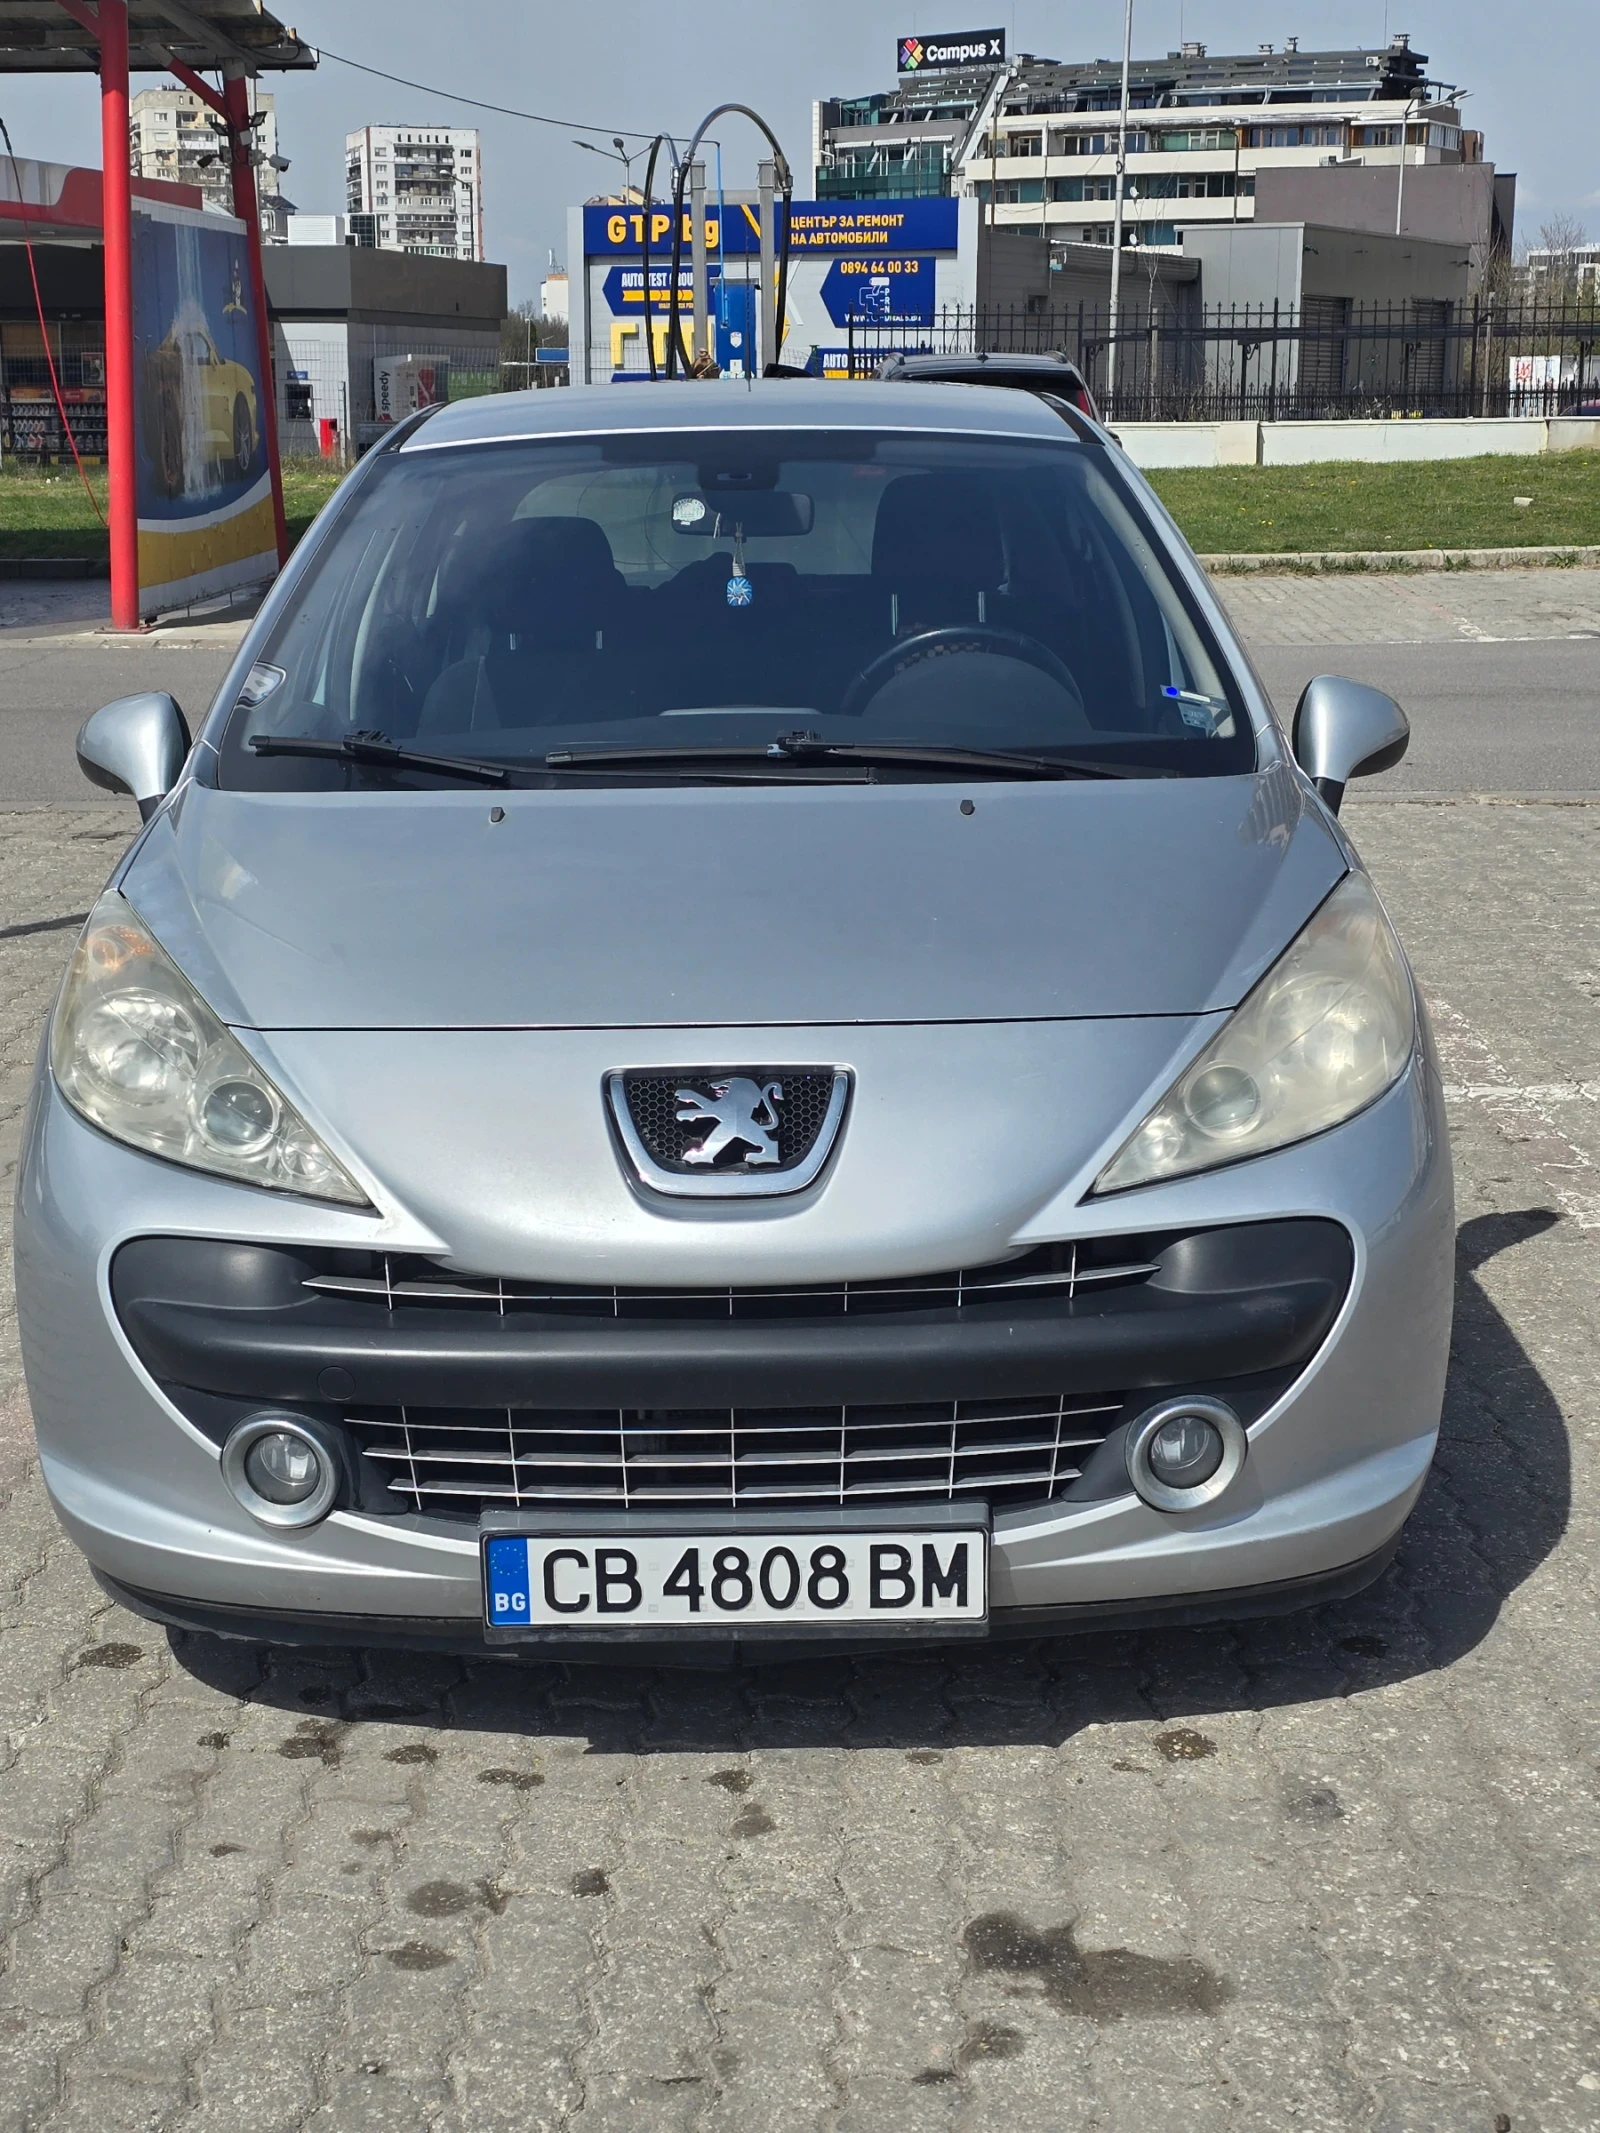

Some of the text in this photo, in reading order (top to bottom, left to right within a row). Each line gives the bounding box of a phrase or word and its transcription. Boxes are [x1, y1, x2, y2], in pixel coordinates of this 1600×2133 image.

[926, 39, 1001, 62] Campus X
[790, 214, 904, 230] ЦЕНТЪР ЗА РЕМОНТ
[791, 231, 888, 245] НА АВТОМОБИЛИ
[840, 260, 919, 274] 0894 64 00 33
[621, 272, 644, 287] AUTO
[823, 353, 848, 368] AUTO
[378, 370, 391, 411] speedy
[494, 1542, 970, 1614] BG CB 4808 BM
